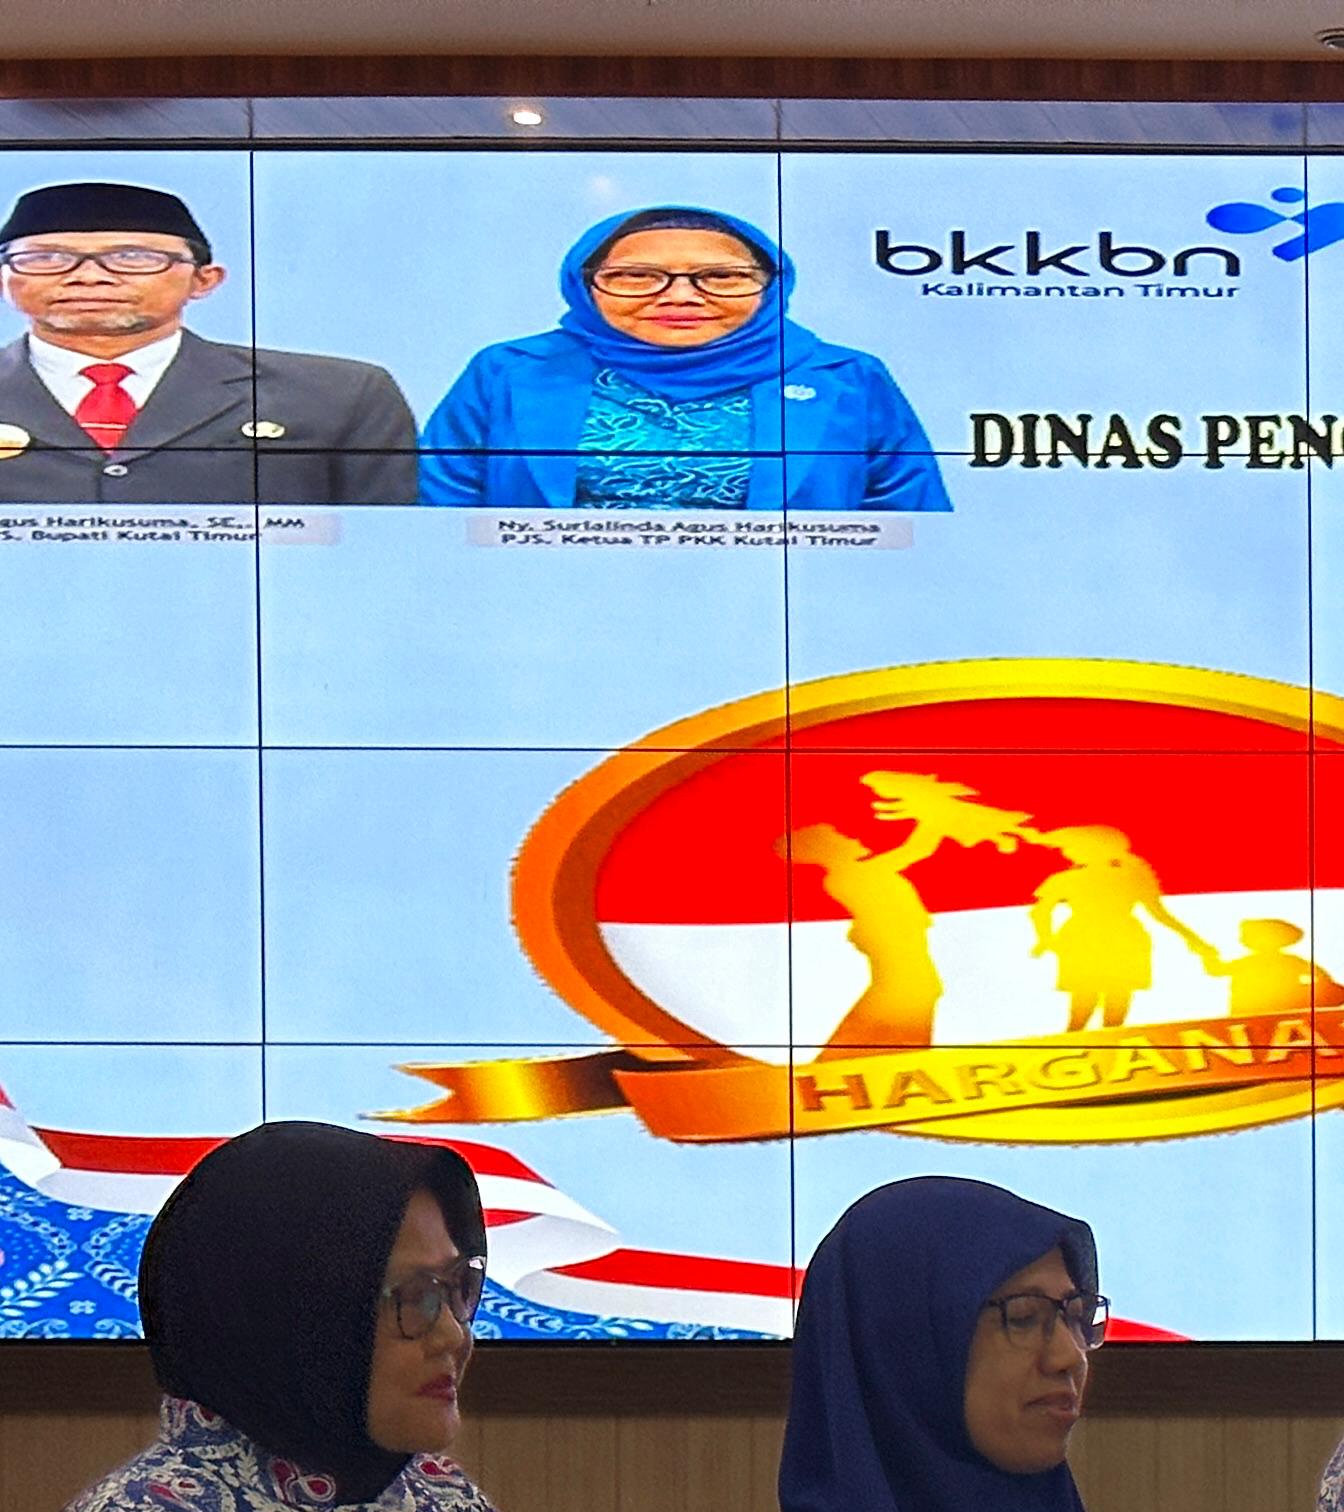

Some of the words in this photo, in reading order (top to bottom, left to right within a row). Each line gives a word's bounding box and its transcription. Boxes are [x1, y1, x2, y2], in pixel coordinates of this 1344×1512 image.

[875, 230, 1241, 277] bkkbn
[921, 283, 1125, 298] Kalimantan
[1134, 283, 1241, 298] Timur
[969, 412, 1184, 470] DINAS
[31, 530, 108, 542] Bupati
[117, 530, 181, 541] Kutai
[188, 530, 262, 541] Timur
[641, 535, 670, 546] TP
[678, 535, 726, 546] PKK
[734, 535, 798, 547] Kutai
[806, 535, 877, 547] Timur
